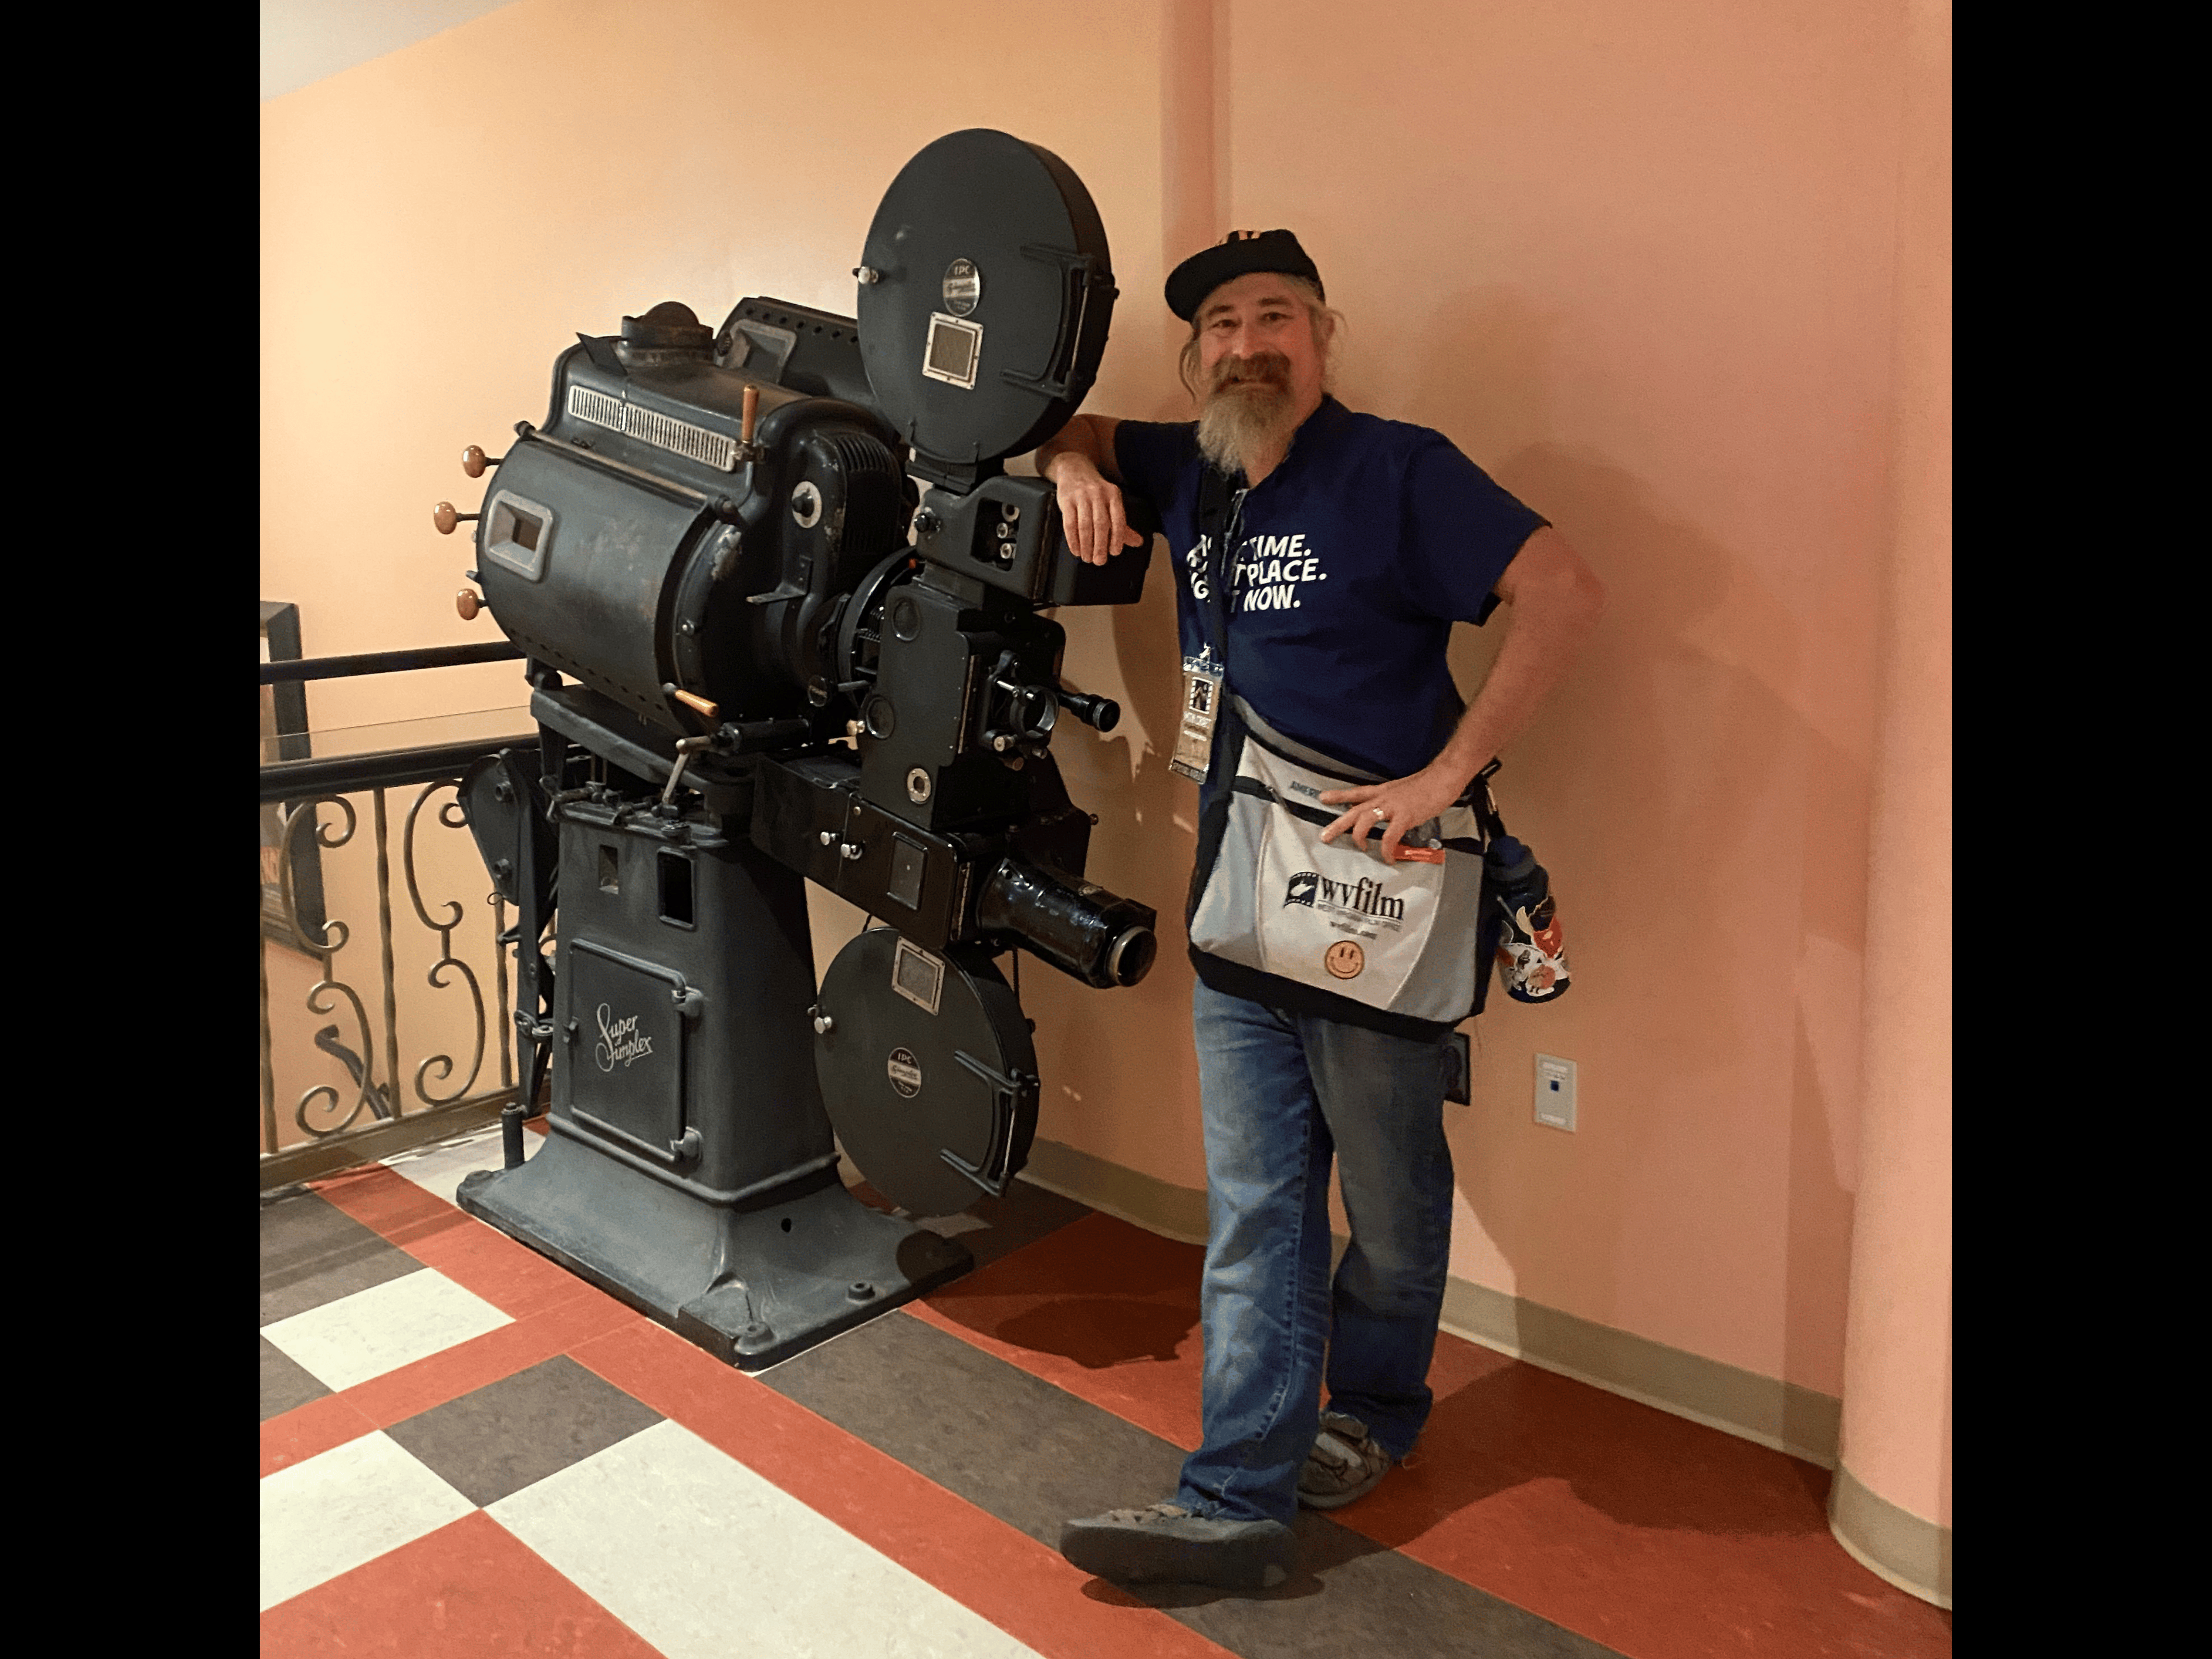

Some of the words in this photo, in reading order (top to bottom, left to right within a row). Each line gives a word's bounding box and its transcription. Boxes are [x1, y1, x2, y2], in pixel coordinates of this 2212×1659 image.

[1247, 558, 1327, 587] PLACE.
[1243, 584, 1301, 612] NOW.
[1322, 877, 1404, 920] wvfilm
[596, 1002, 638, 1047] Super
[595, 1028, 653, 1072] Simplex
